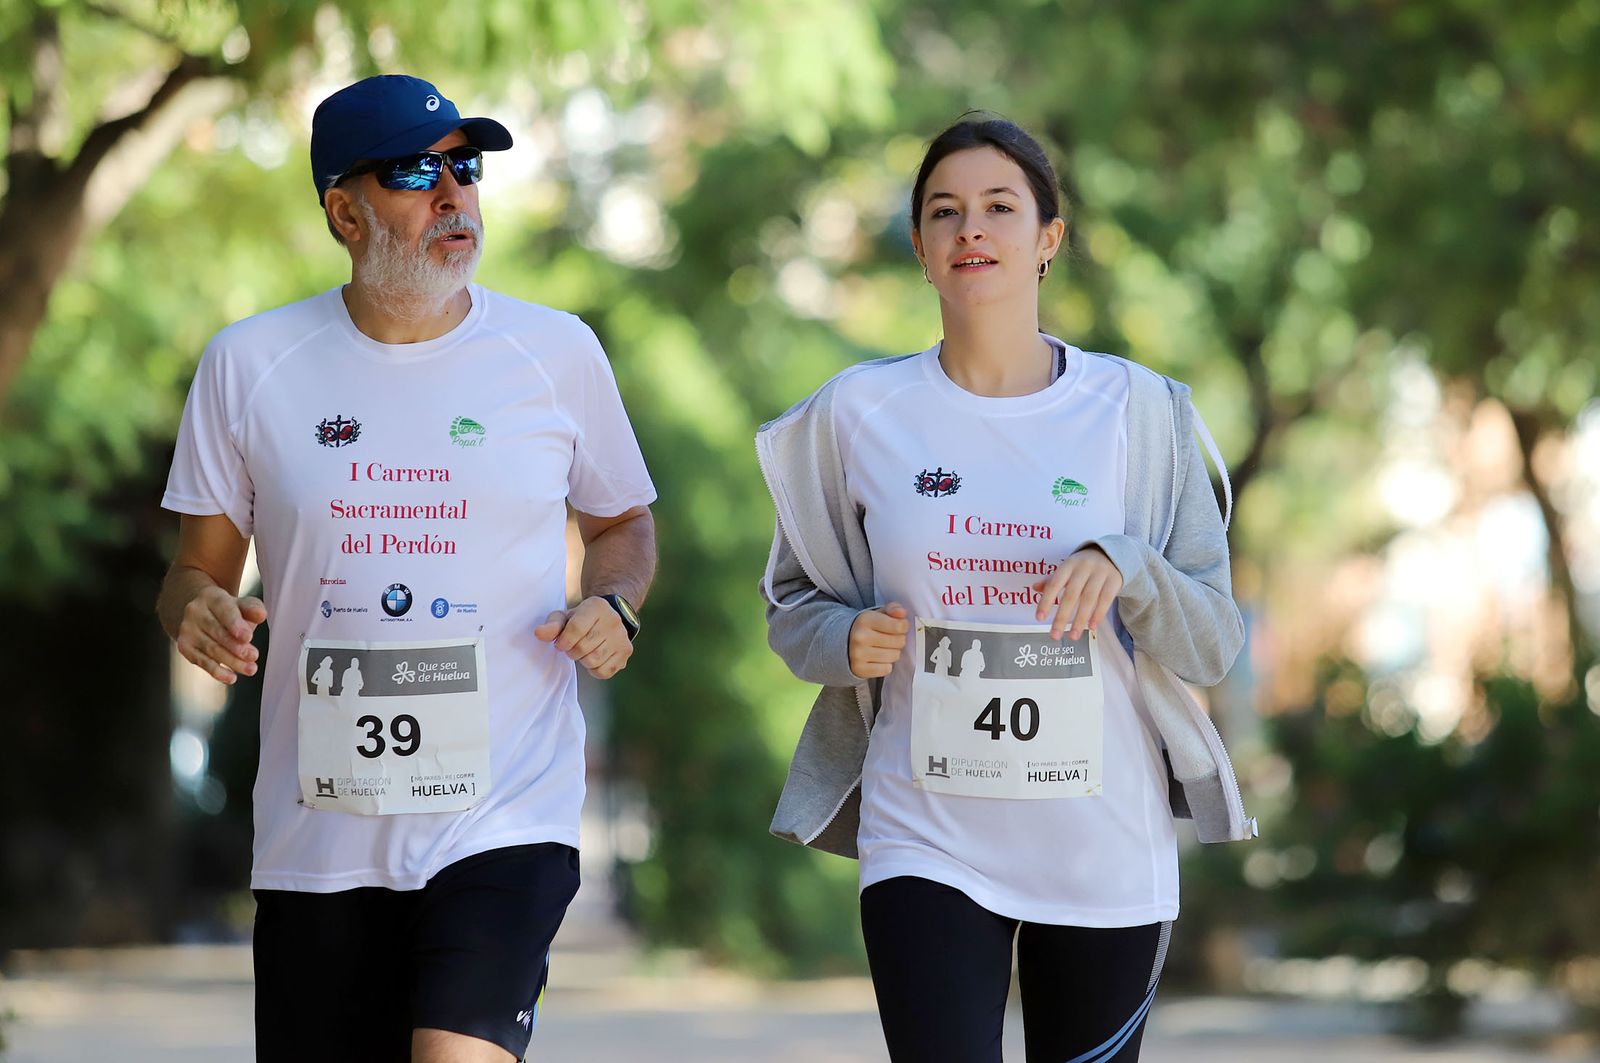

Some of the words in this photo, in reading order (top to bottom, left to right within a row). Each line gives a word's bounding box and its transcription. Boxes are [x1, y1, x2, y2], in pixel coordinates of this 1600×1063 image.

[349, 462, 360, 482] I
[366, 462, 452, 482] Carrera
[330, 499, 468, 519] Sacramental
[946, 514, 957, 534] I
[964, 515, 1053, 540] Carrera
[341, 534, 371, 554] del
[379, 534, 457, 554] Perdón
[927, 551, 1064, 576] Sacramenta
[941, 585, 973, 606] del
[981, 585, 1060, 606] Perd
[1040, 645, 1060, 656] Que
[1062, 646, 1074, 655] sea
[418, 662, 438, 673] Que
[440, 661, 458, 670] sea
[1040, 656, 1053, 666] de
[1055, 655, 1085, 666] Huelva
[418, 672, 431, 683] de
[433, 670, 470, 682] Huelva
[973, 697, 1040, 742] 40
[356, 714, 421, 758] 39
[951, 756, 1008, 769] DIPUTACIÓN
[951, 768, 963, 776] DE
[965, 769, 1002, 778] HUELVA
[1027, 769, 1080, 782] HUELVA
[337, 776, 392, 787] DIPUTACIÓN
[337, 787, 348, 796] DE
[351, 787, 386, 796] HUELVA
[411, 783, 468, 797] HUELVA
